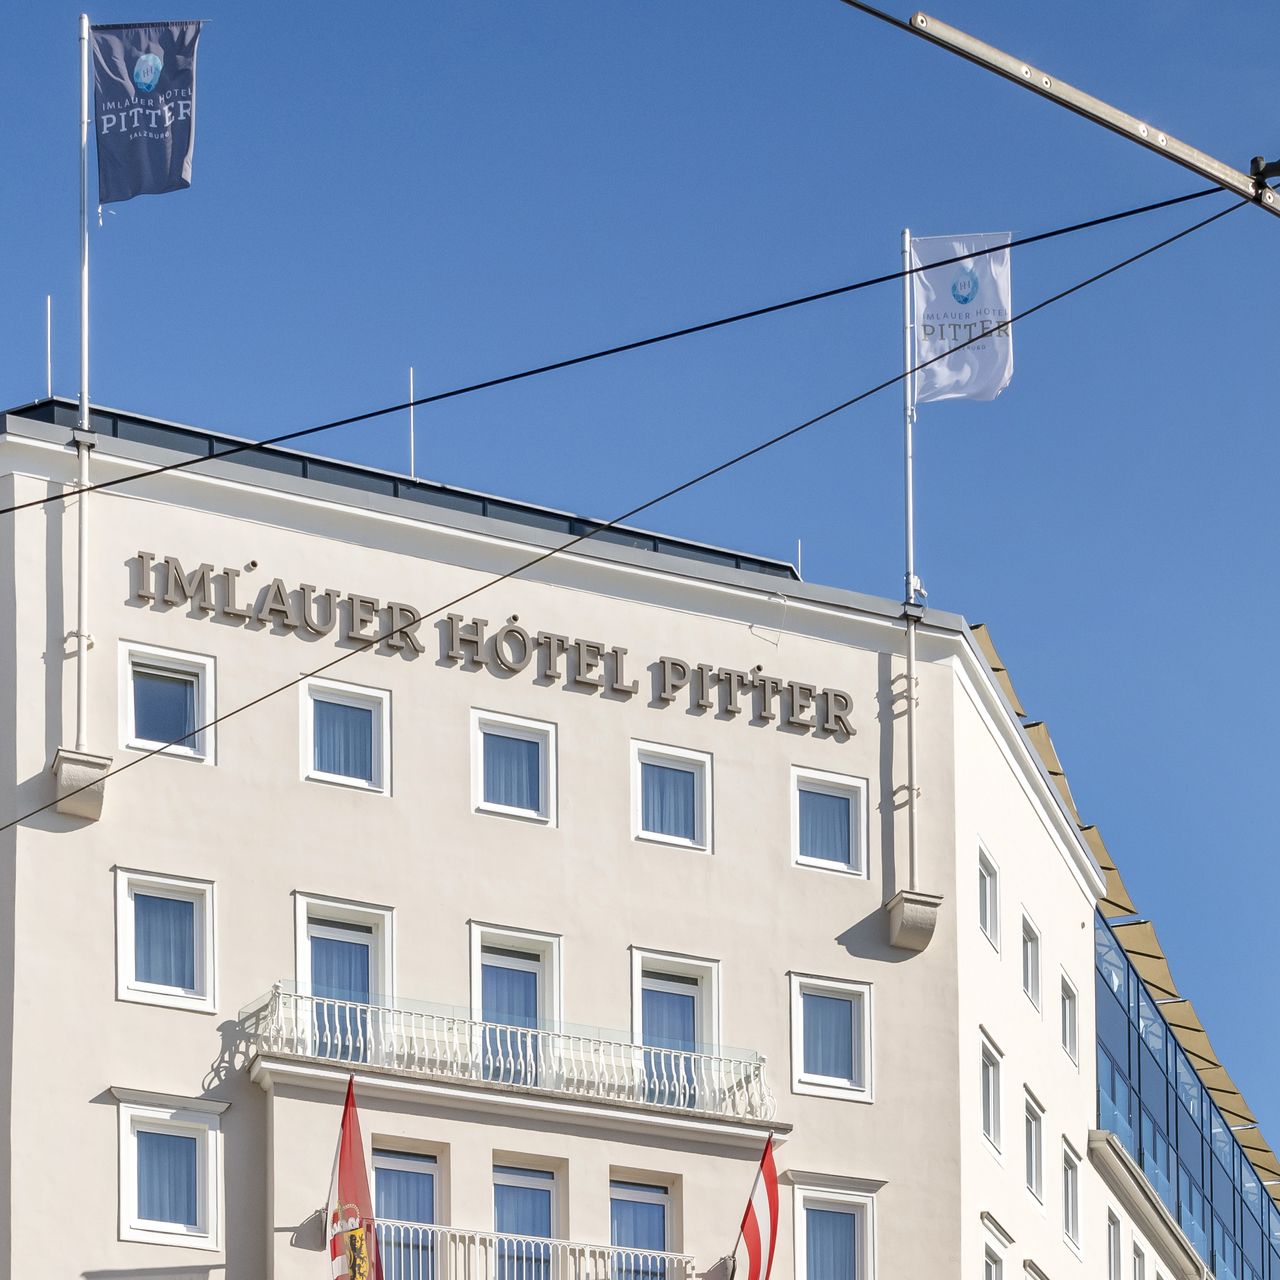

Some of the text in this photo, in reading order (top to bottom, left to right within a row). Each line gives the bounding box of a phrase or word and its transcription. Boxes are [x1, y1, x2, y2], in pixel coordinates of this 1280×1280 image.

[102, 87, 193, 112] IMLAUER HOTEL
[101, 100, 192, 135] PITTER
[129, 130, 171, 140] SALZBURG
[921, 319, 1010, 342] PITTER
[134, 550, 857, 737] IMLAUER HOTEL PITTER
